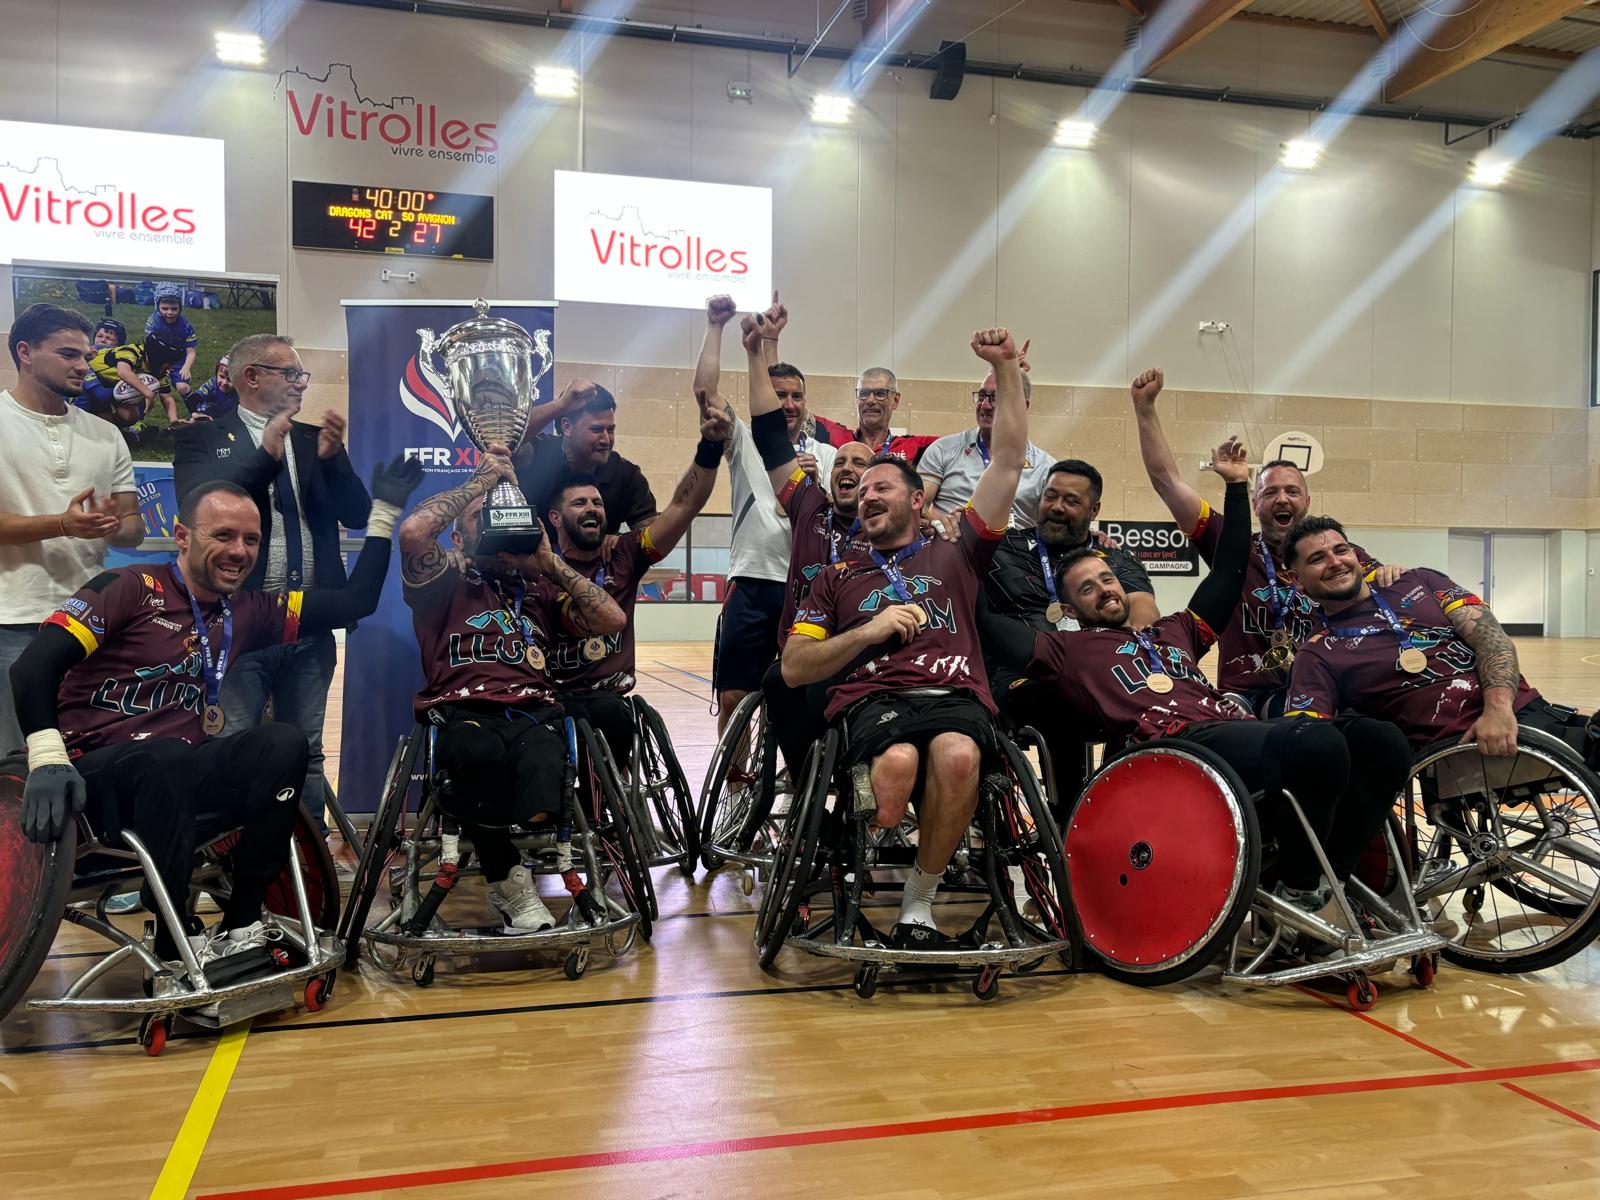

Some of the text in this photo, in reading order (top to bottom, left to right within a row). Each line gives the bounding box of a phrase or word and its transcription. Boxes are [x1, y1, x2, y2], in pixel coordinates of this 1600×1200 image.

[286, 89, 498, 153] Vitrolles
[391, 145, 497, 165] vivre ensemble
[0, 182, 195, 234] Vitrolles
[366, 189, 425, 211] 40:00
[329, 206, 456, 225] DRAGONS CAT SO AVIGNON
[94, 229, 194, 246] vivre ensemble
[349, 218, 441, 243] 42 2 27
[590, 228, 749, 275] Vitrolles
